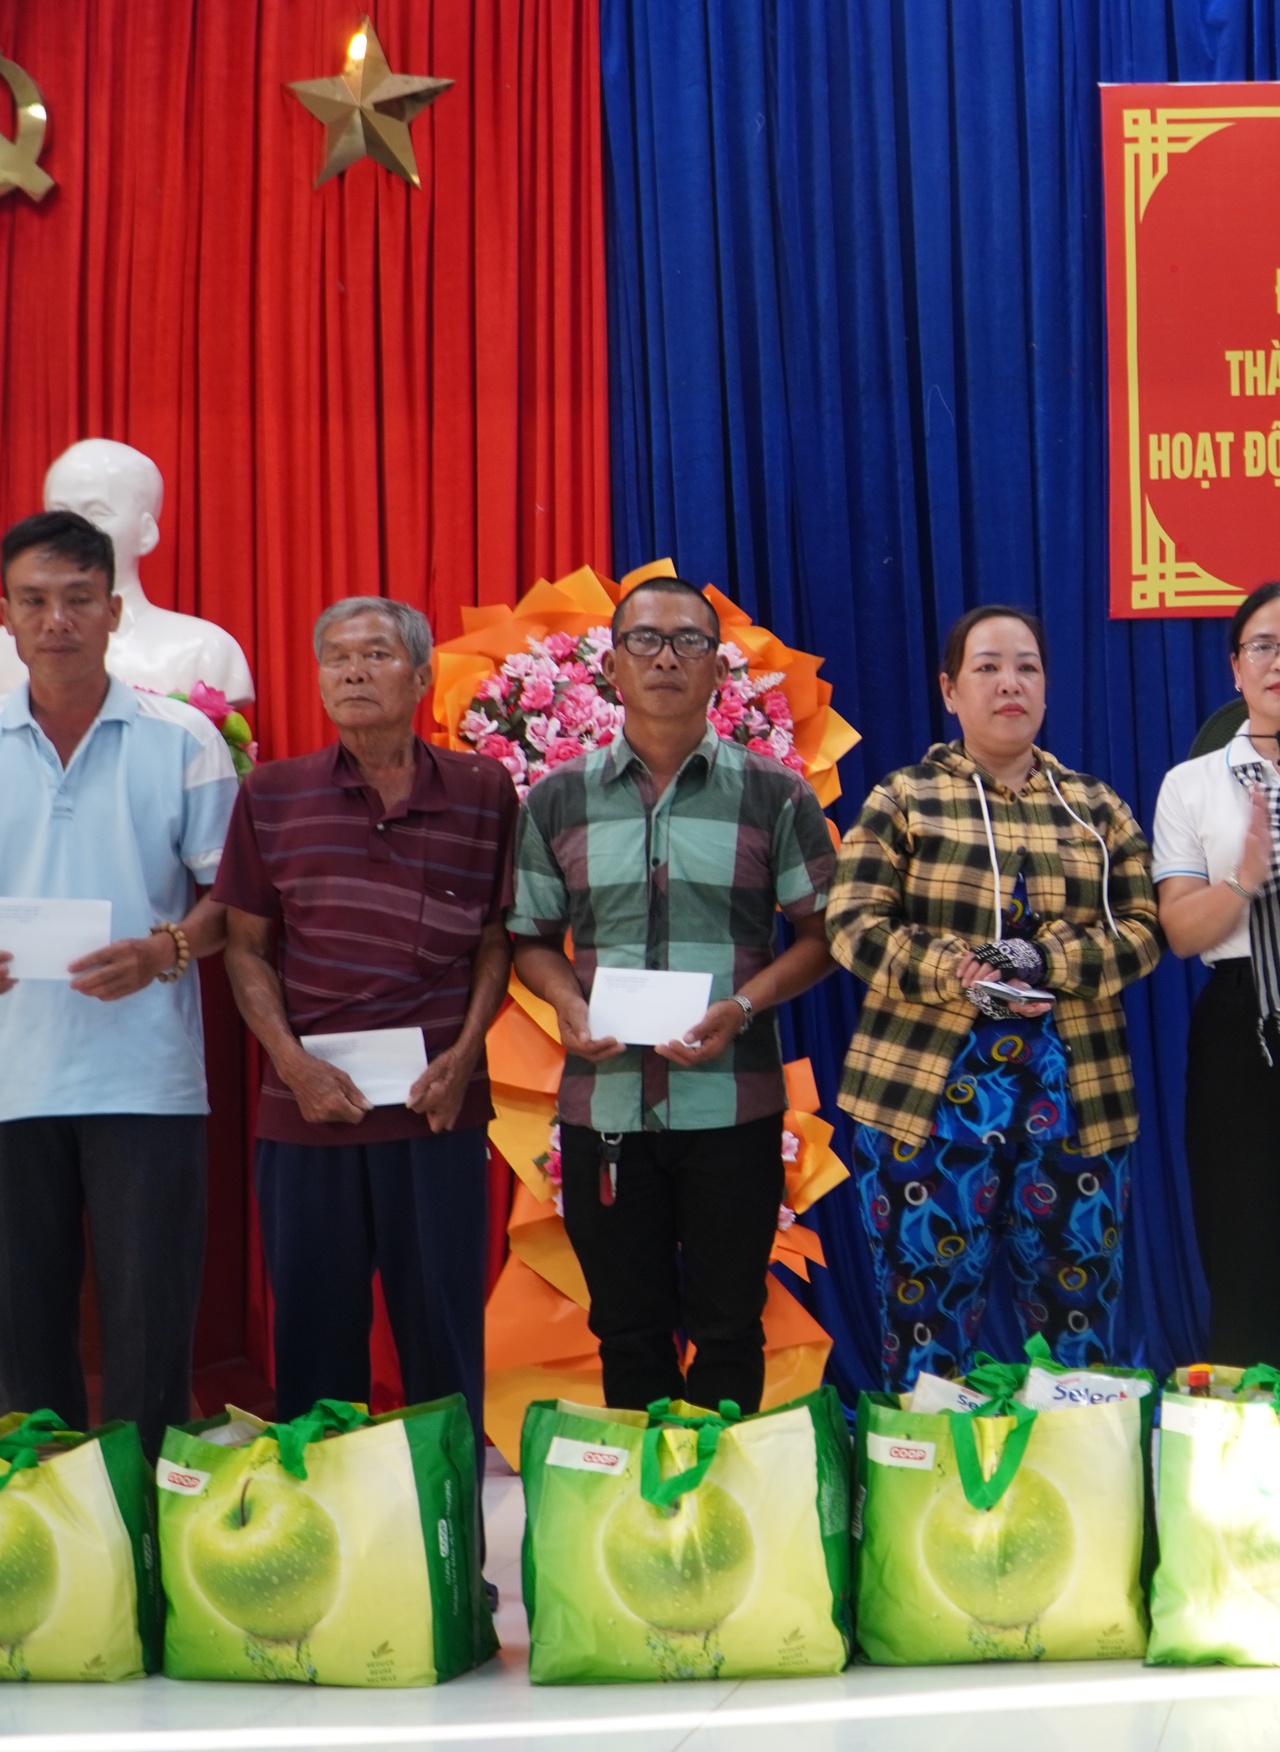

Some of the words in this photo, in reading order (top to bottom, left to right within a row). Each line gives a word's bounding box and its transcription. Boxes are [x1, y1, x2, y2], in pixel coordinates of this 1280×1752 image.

[1148, 431, 1235, 489] HOẠT
[583, 1451, 618, 1466] COOP
[890, 1446, 926, 1460] COOP
